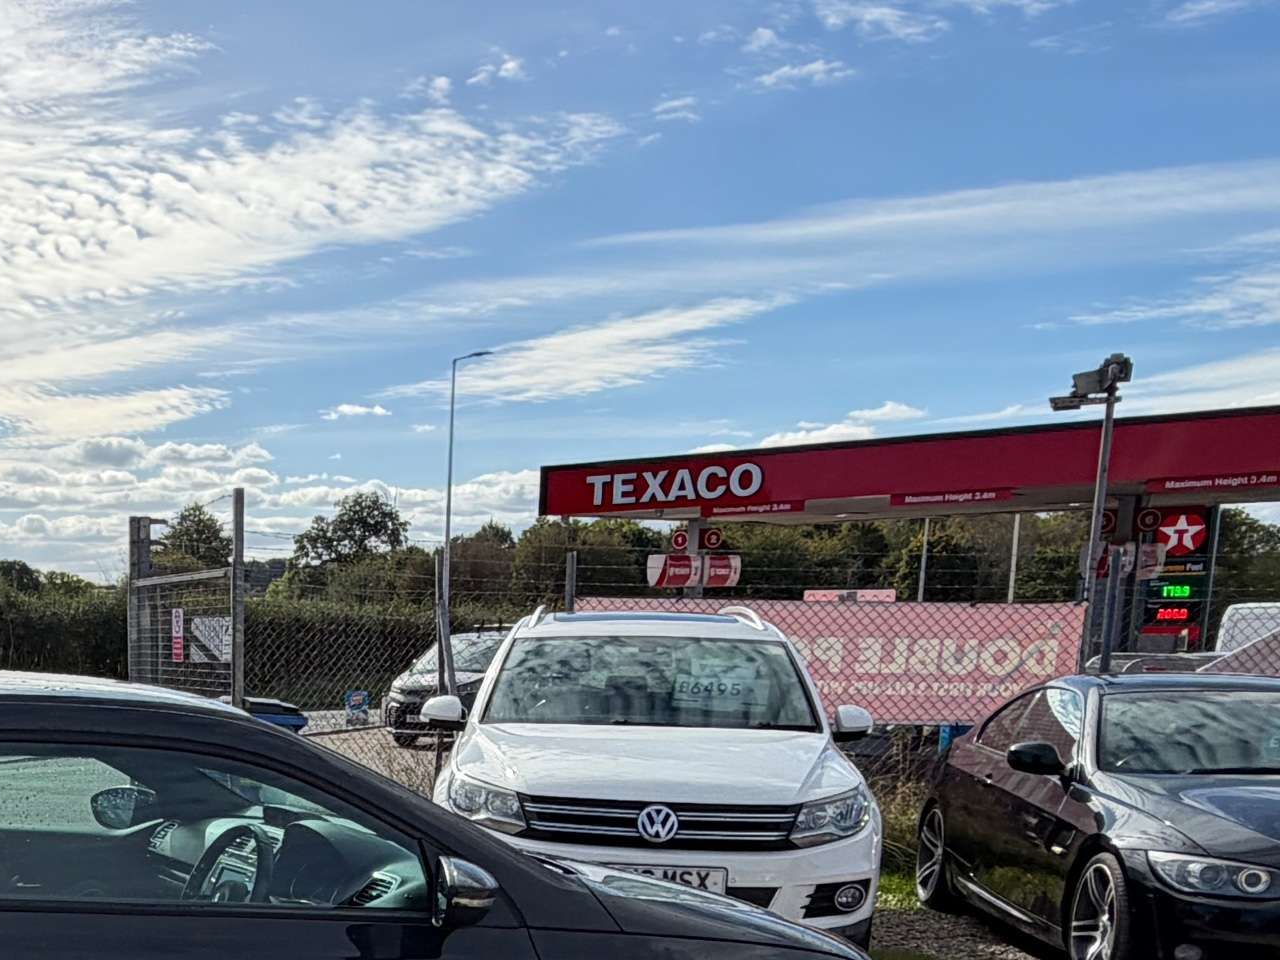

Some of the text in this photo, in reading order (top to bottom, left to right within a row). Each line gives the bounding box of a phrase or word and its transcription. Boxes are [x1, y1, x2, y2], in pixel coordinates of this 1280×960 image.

[586, 462, 764, 506] TEXACO
[1165, 480, 1212, 489] Maximum
[1215, 477, 1248, 487] Height
[678, 681, 741, 696] £6495
